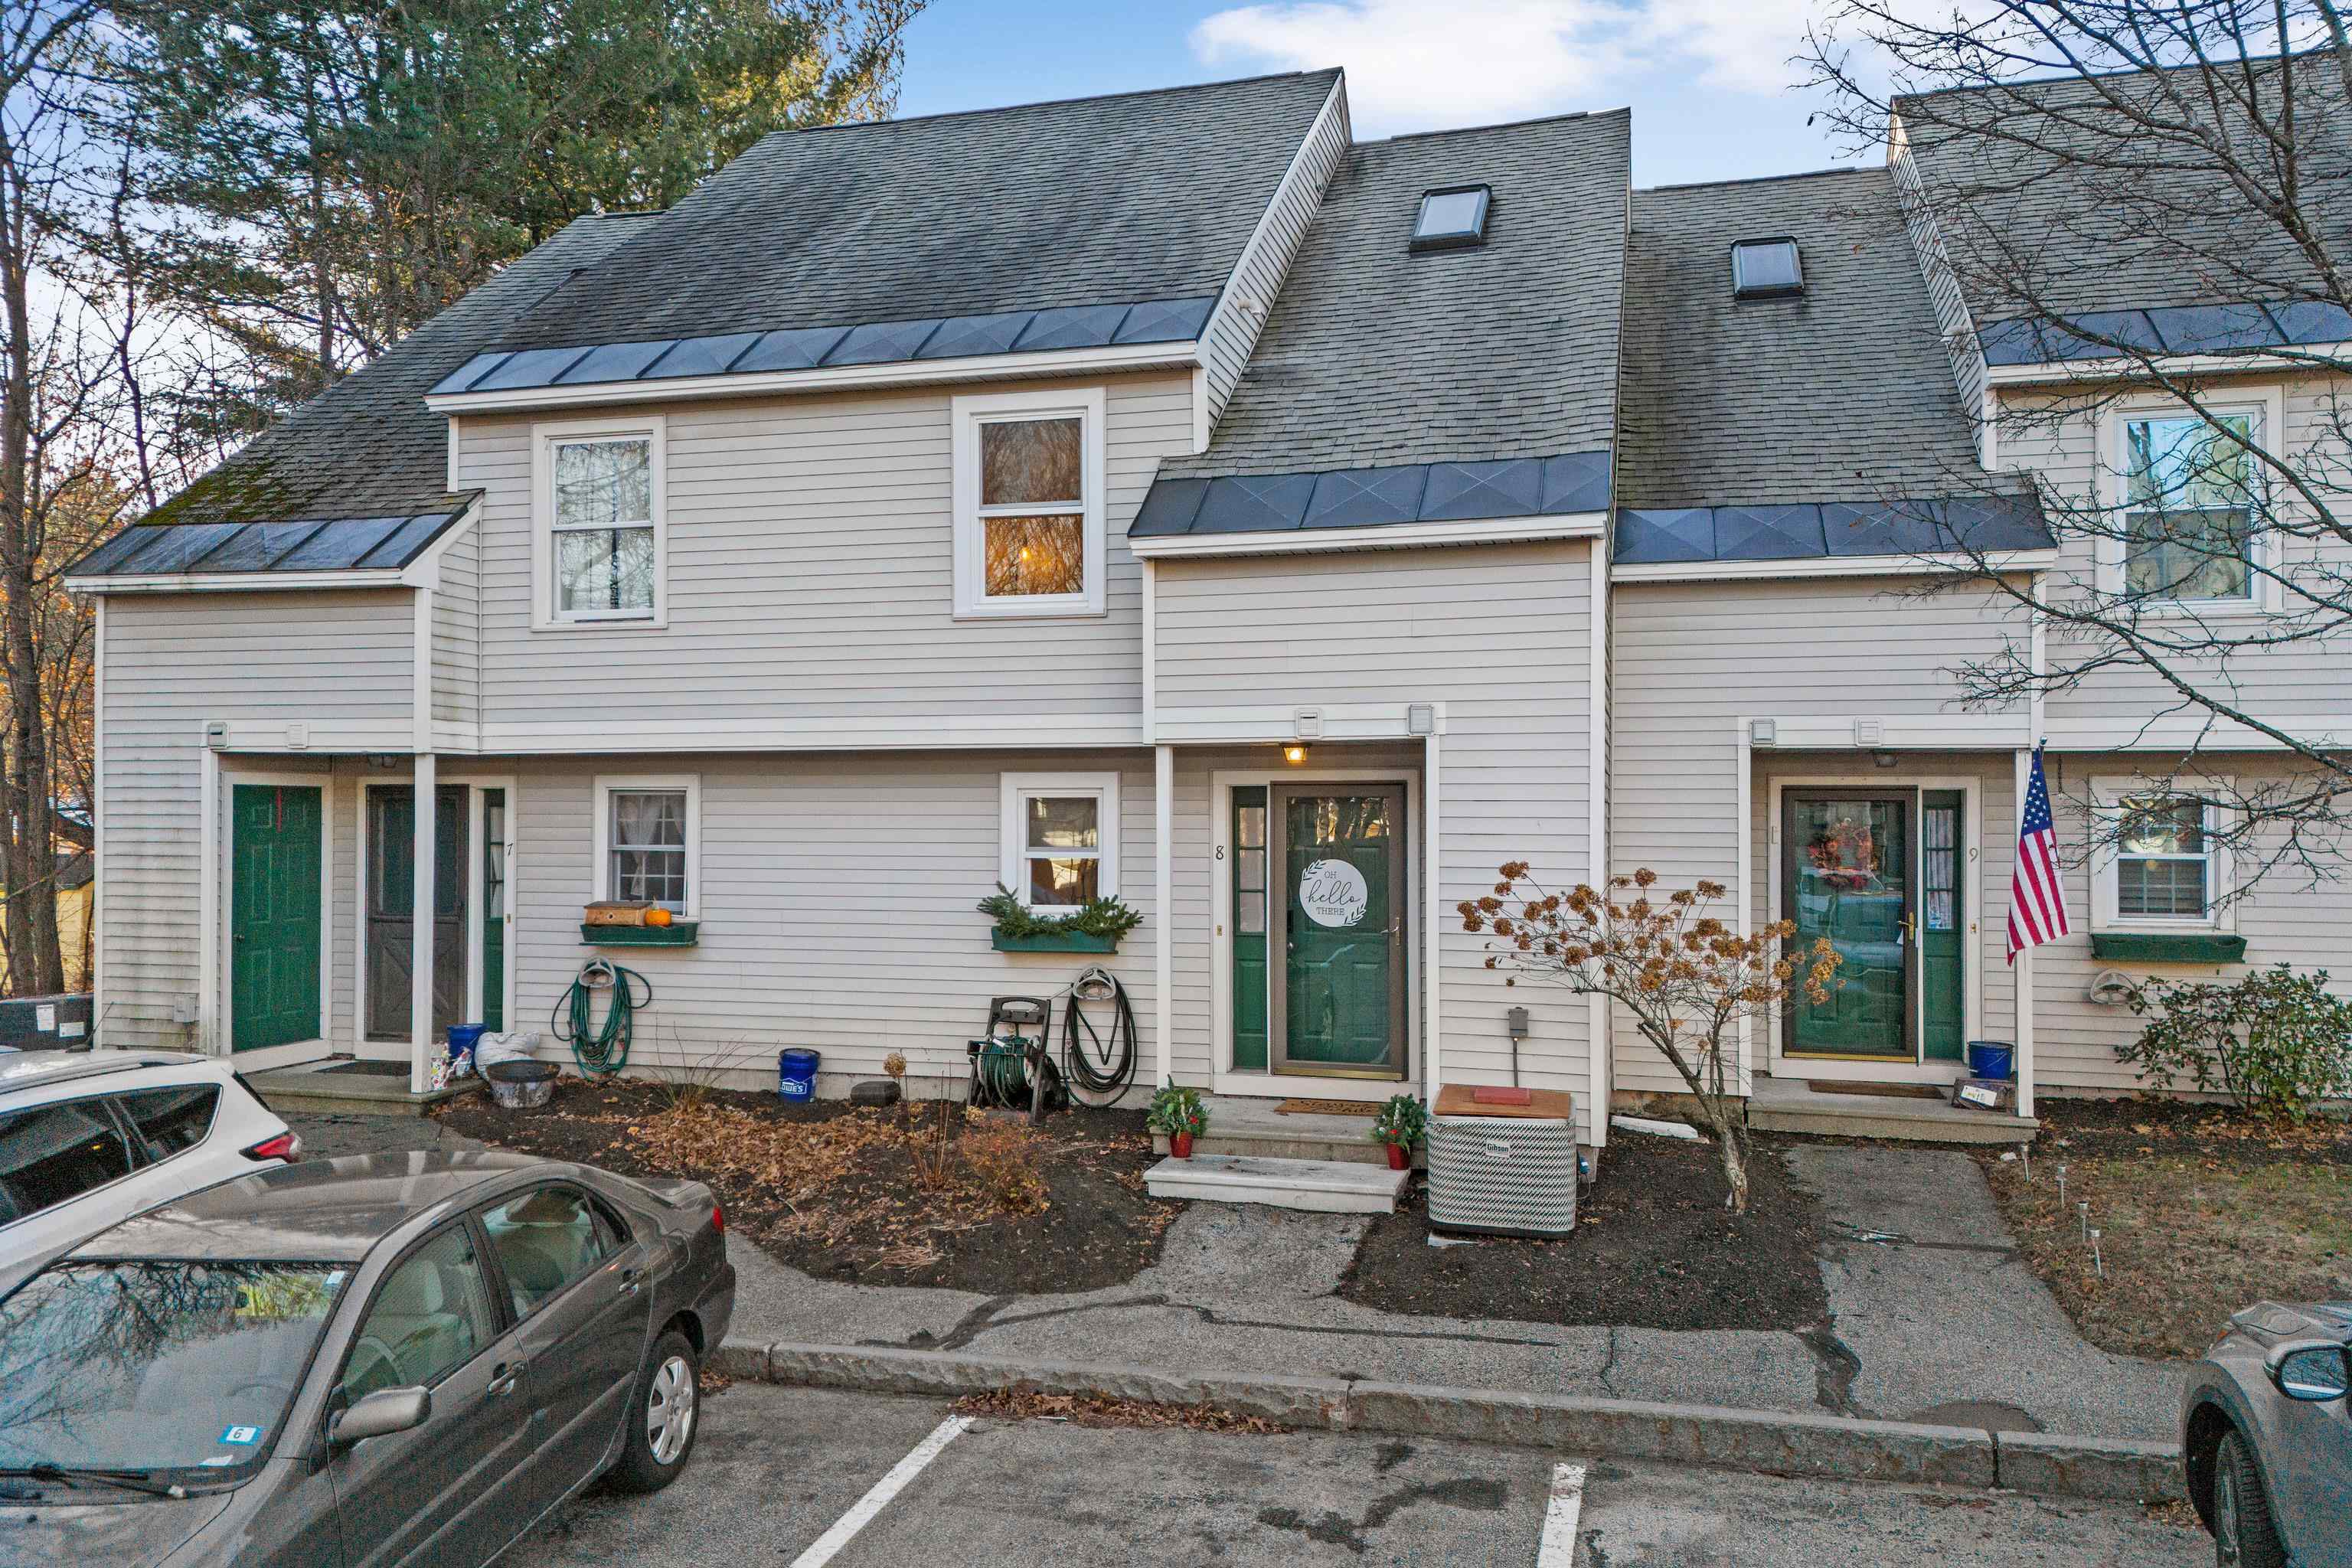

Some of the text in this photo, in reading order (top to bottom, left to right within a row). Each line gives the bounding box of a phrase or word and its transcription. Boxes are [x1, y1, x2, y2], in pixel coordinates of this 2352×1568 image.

[506, 842, 514, 857] 7
[1216, 844, 1225, 860] 8
[1969, 847, 1978, 863] 9
[1324, 871, 1338, 879] OH
[1305, 879, 1361, 905] hello
[1316, 906, 1345, 916] THERE
[1487, 1143, 1509, 1152] Gibson
[234, 1428, 244, 1439] 6
